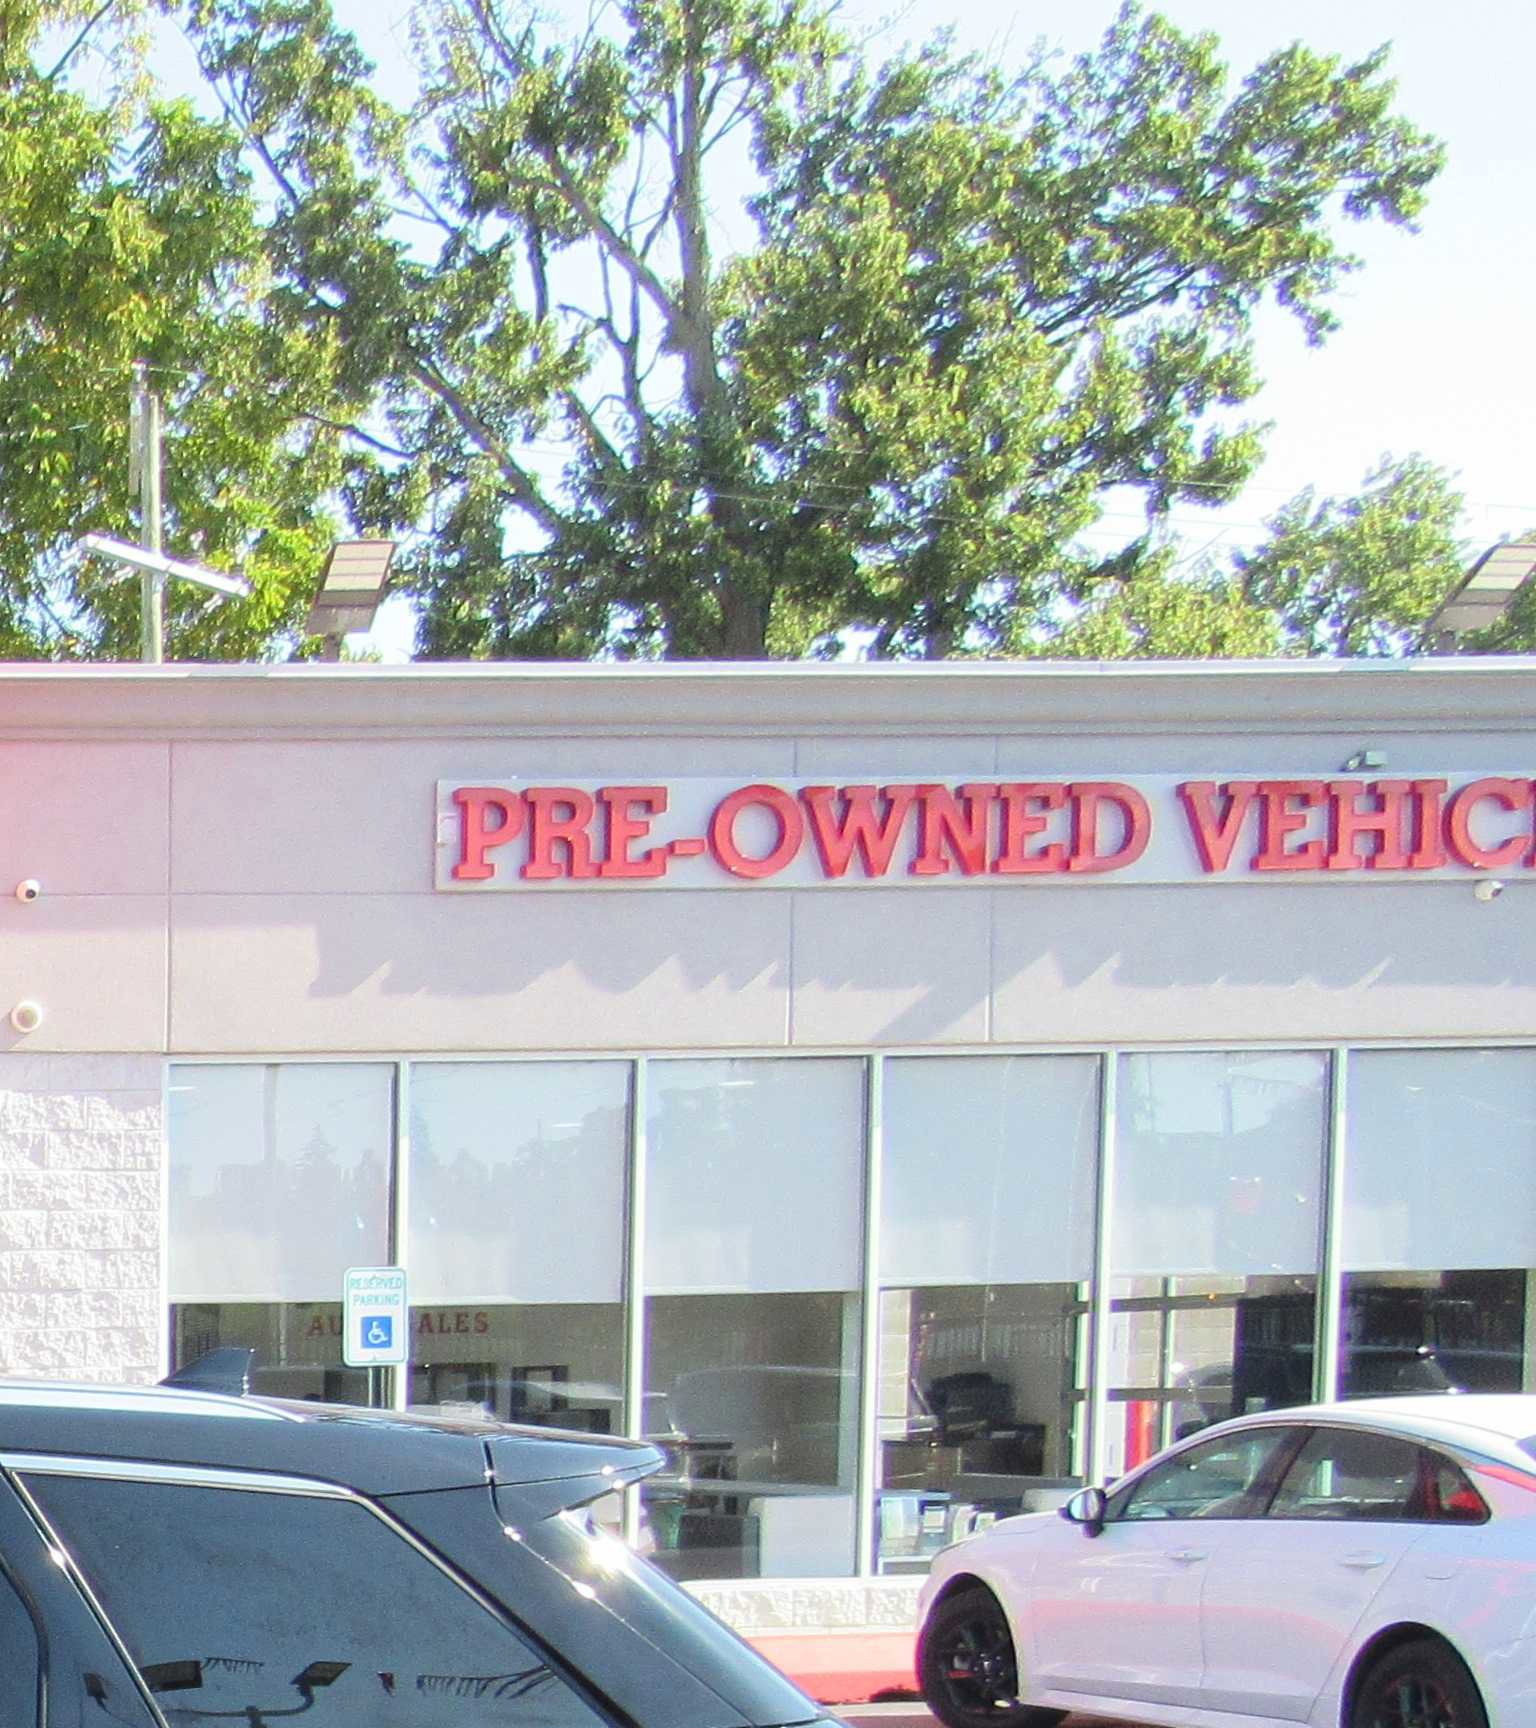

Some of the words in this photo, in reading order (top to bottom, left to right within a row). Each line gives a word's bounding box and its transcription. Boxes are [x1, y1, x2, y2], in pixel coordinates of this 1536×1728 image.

[451, 783, 1152, 880] PRE-OWNED
[349, 1276, 403, 1290] RESERVED
[352, 1293, 401, 1306] PARKING
[417, 1312, 490, 1334] ALES
